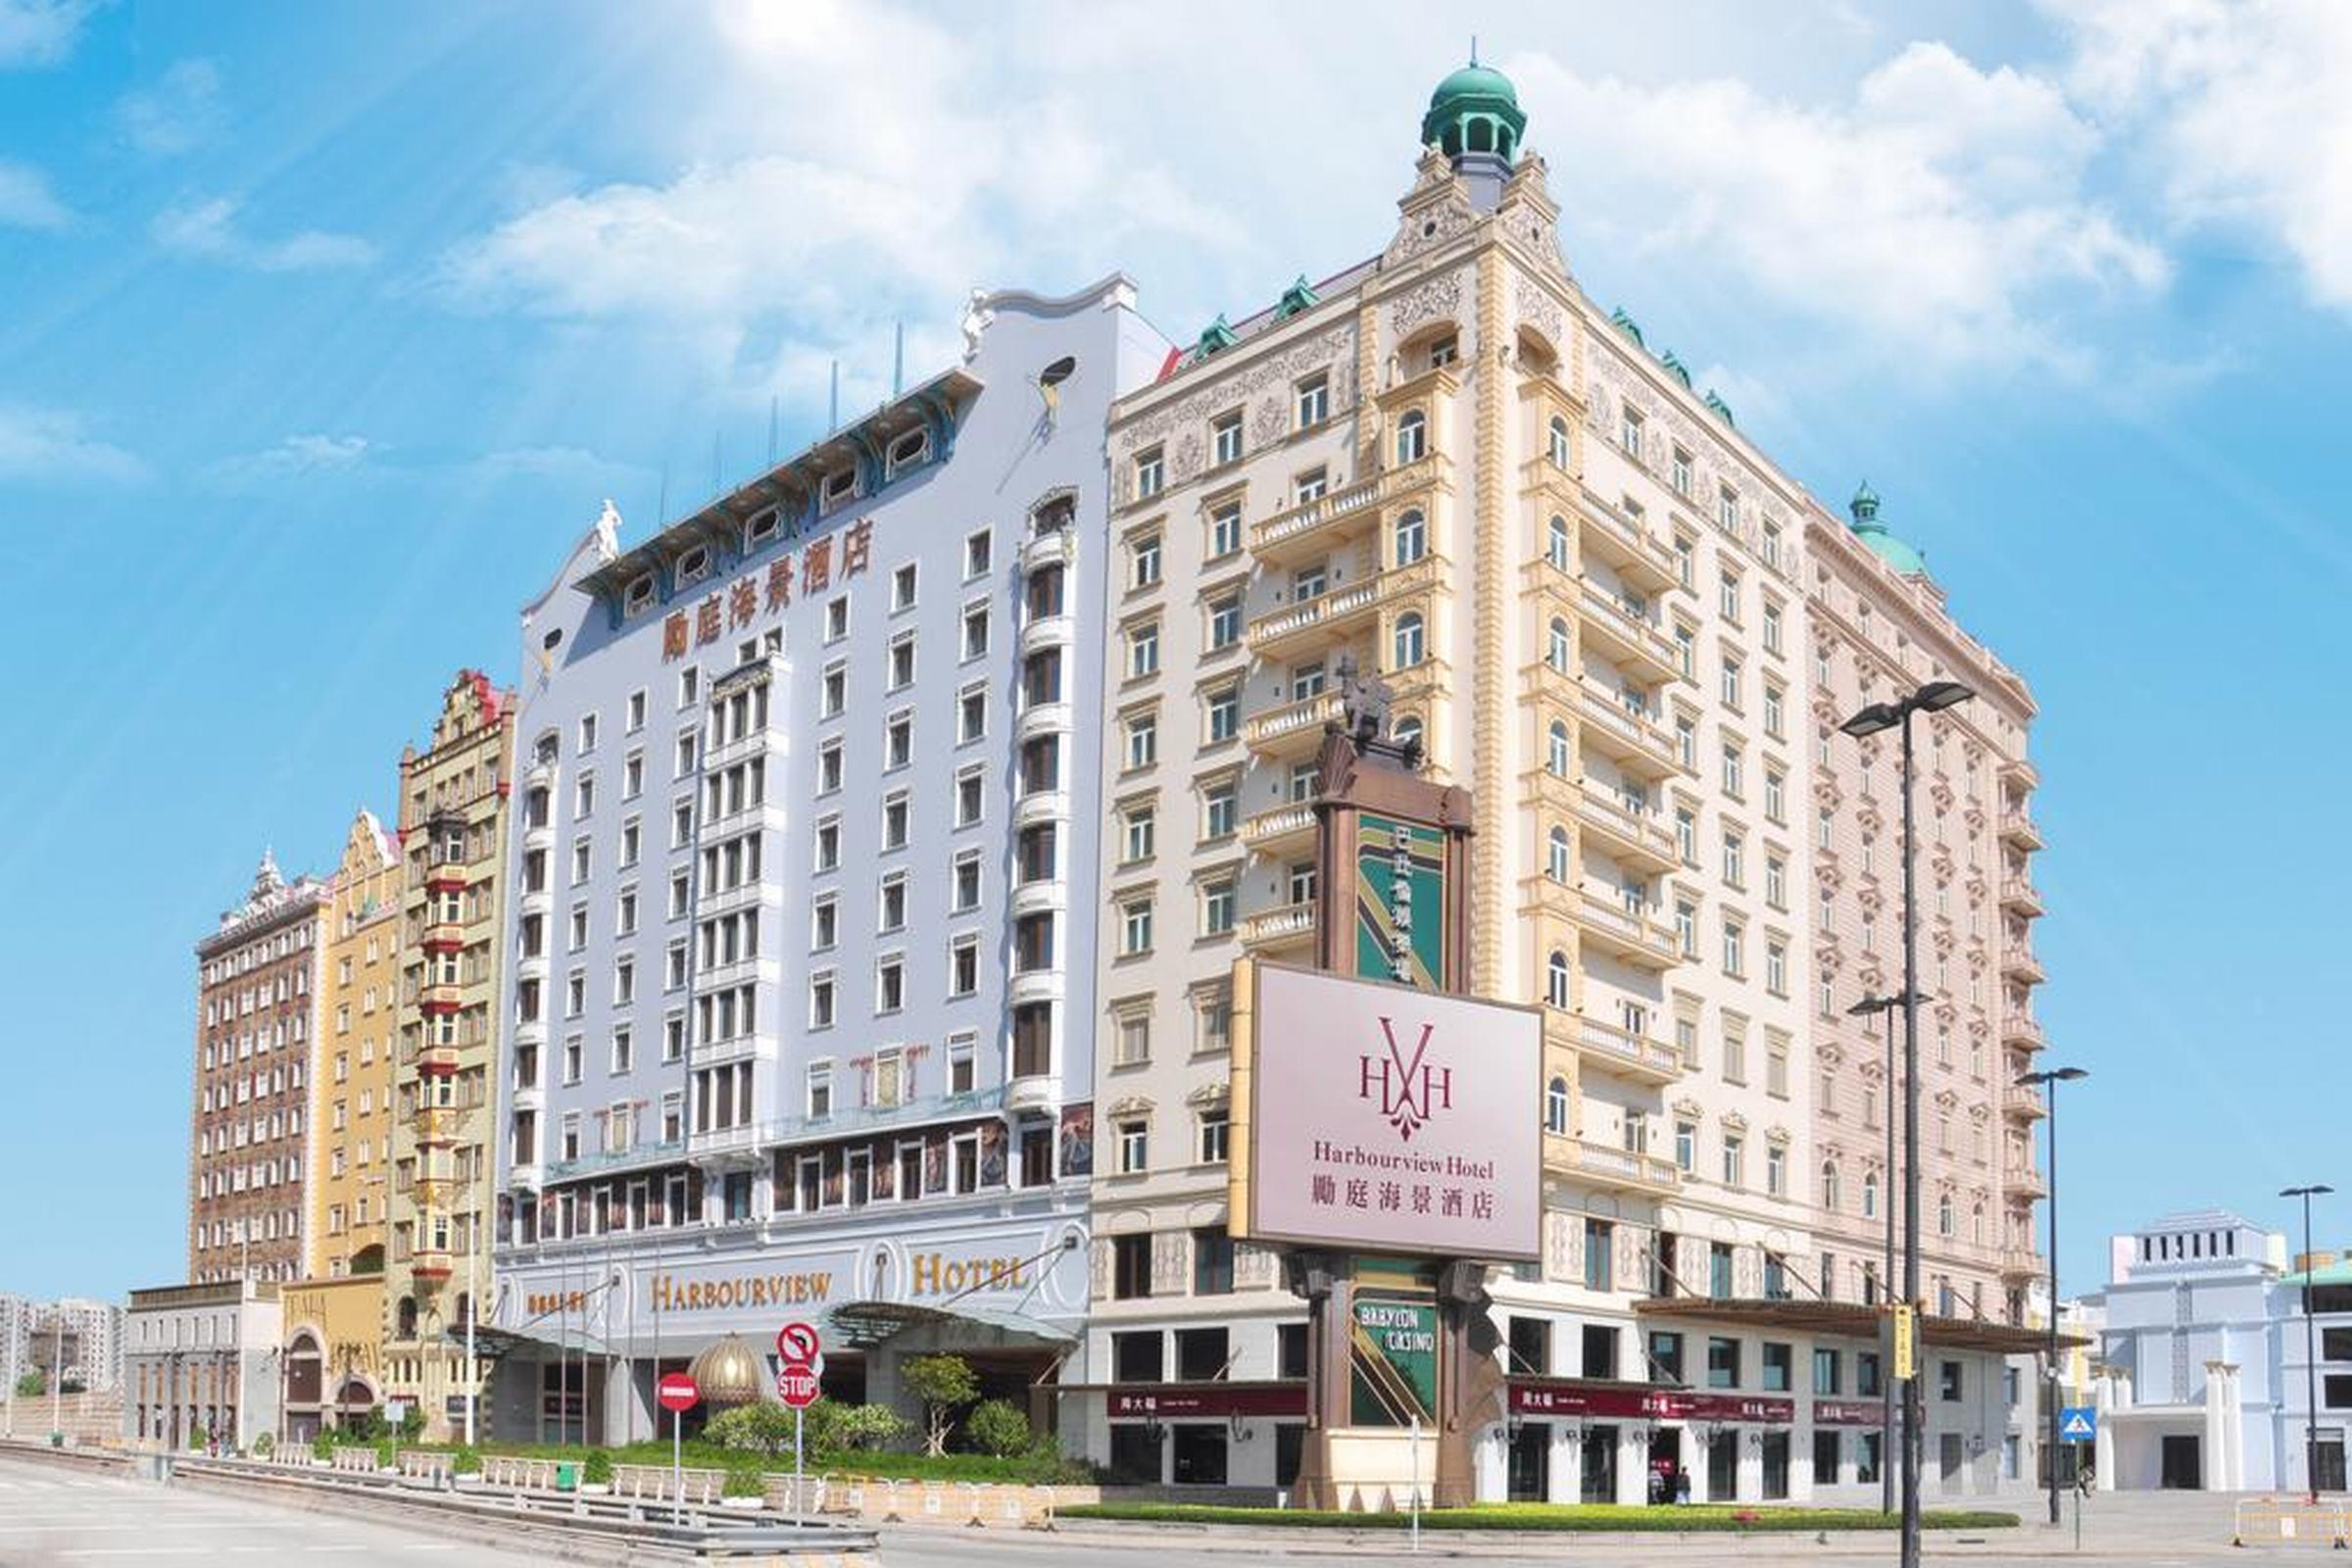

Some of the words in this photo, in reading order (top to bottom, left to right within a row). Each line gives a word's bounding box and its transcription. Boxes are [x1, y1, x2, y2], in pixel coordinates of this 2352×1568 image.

[1314, 1141, 1442, 1173] Harbourview
[1446, 1156, 1494, 1180] Hotel
[651, 1273, 832, 1312] HARBOURVIEW
[912, 1253, 1029, 1295] HOTEL
[1361, 1307, 1418, 1328] BABYLON
[1385, 1330, 1434, 1351] CASINO
[780, 1376, 815, 1396] STOP
